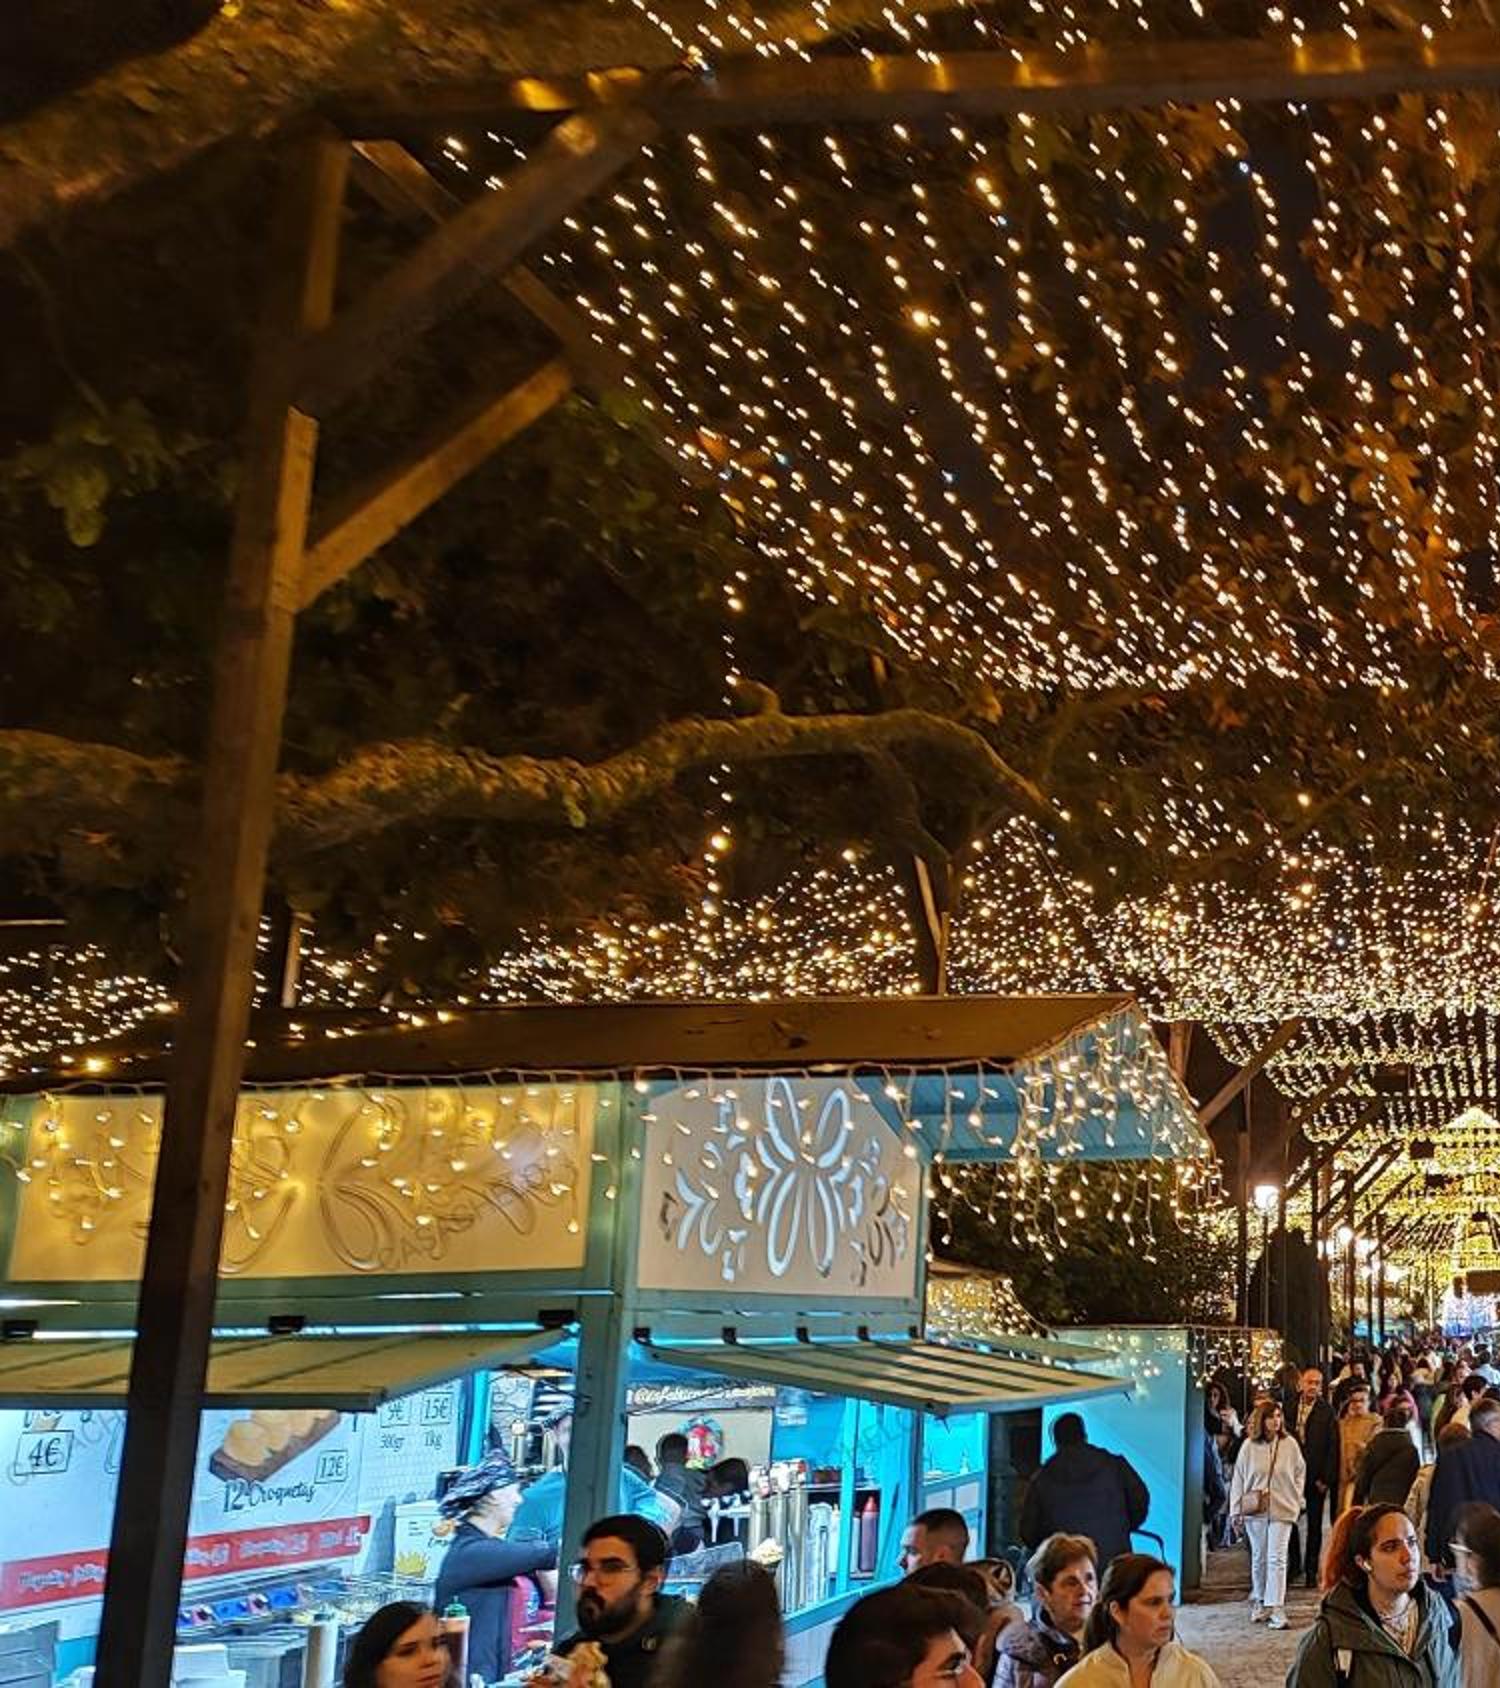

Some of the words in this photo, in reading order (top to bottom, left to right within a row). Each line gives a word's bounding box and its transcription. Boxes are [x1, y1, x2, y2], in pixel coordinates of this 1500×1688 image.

[424, 1398, 449, 1420] 15€
[28, 1437, 62, 1468] 4€
[320, 1456, 345, 1477] 12€
